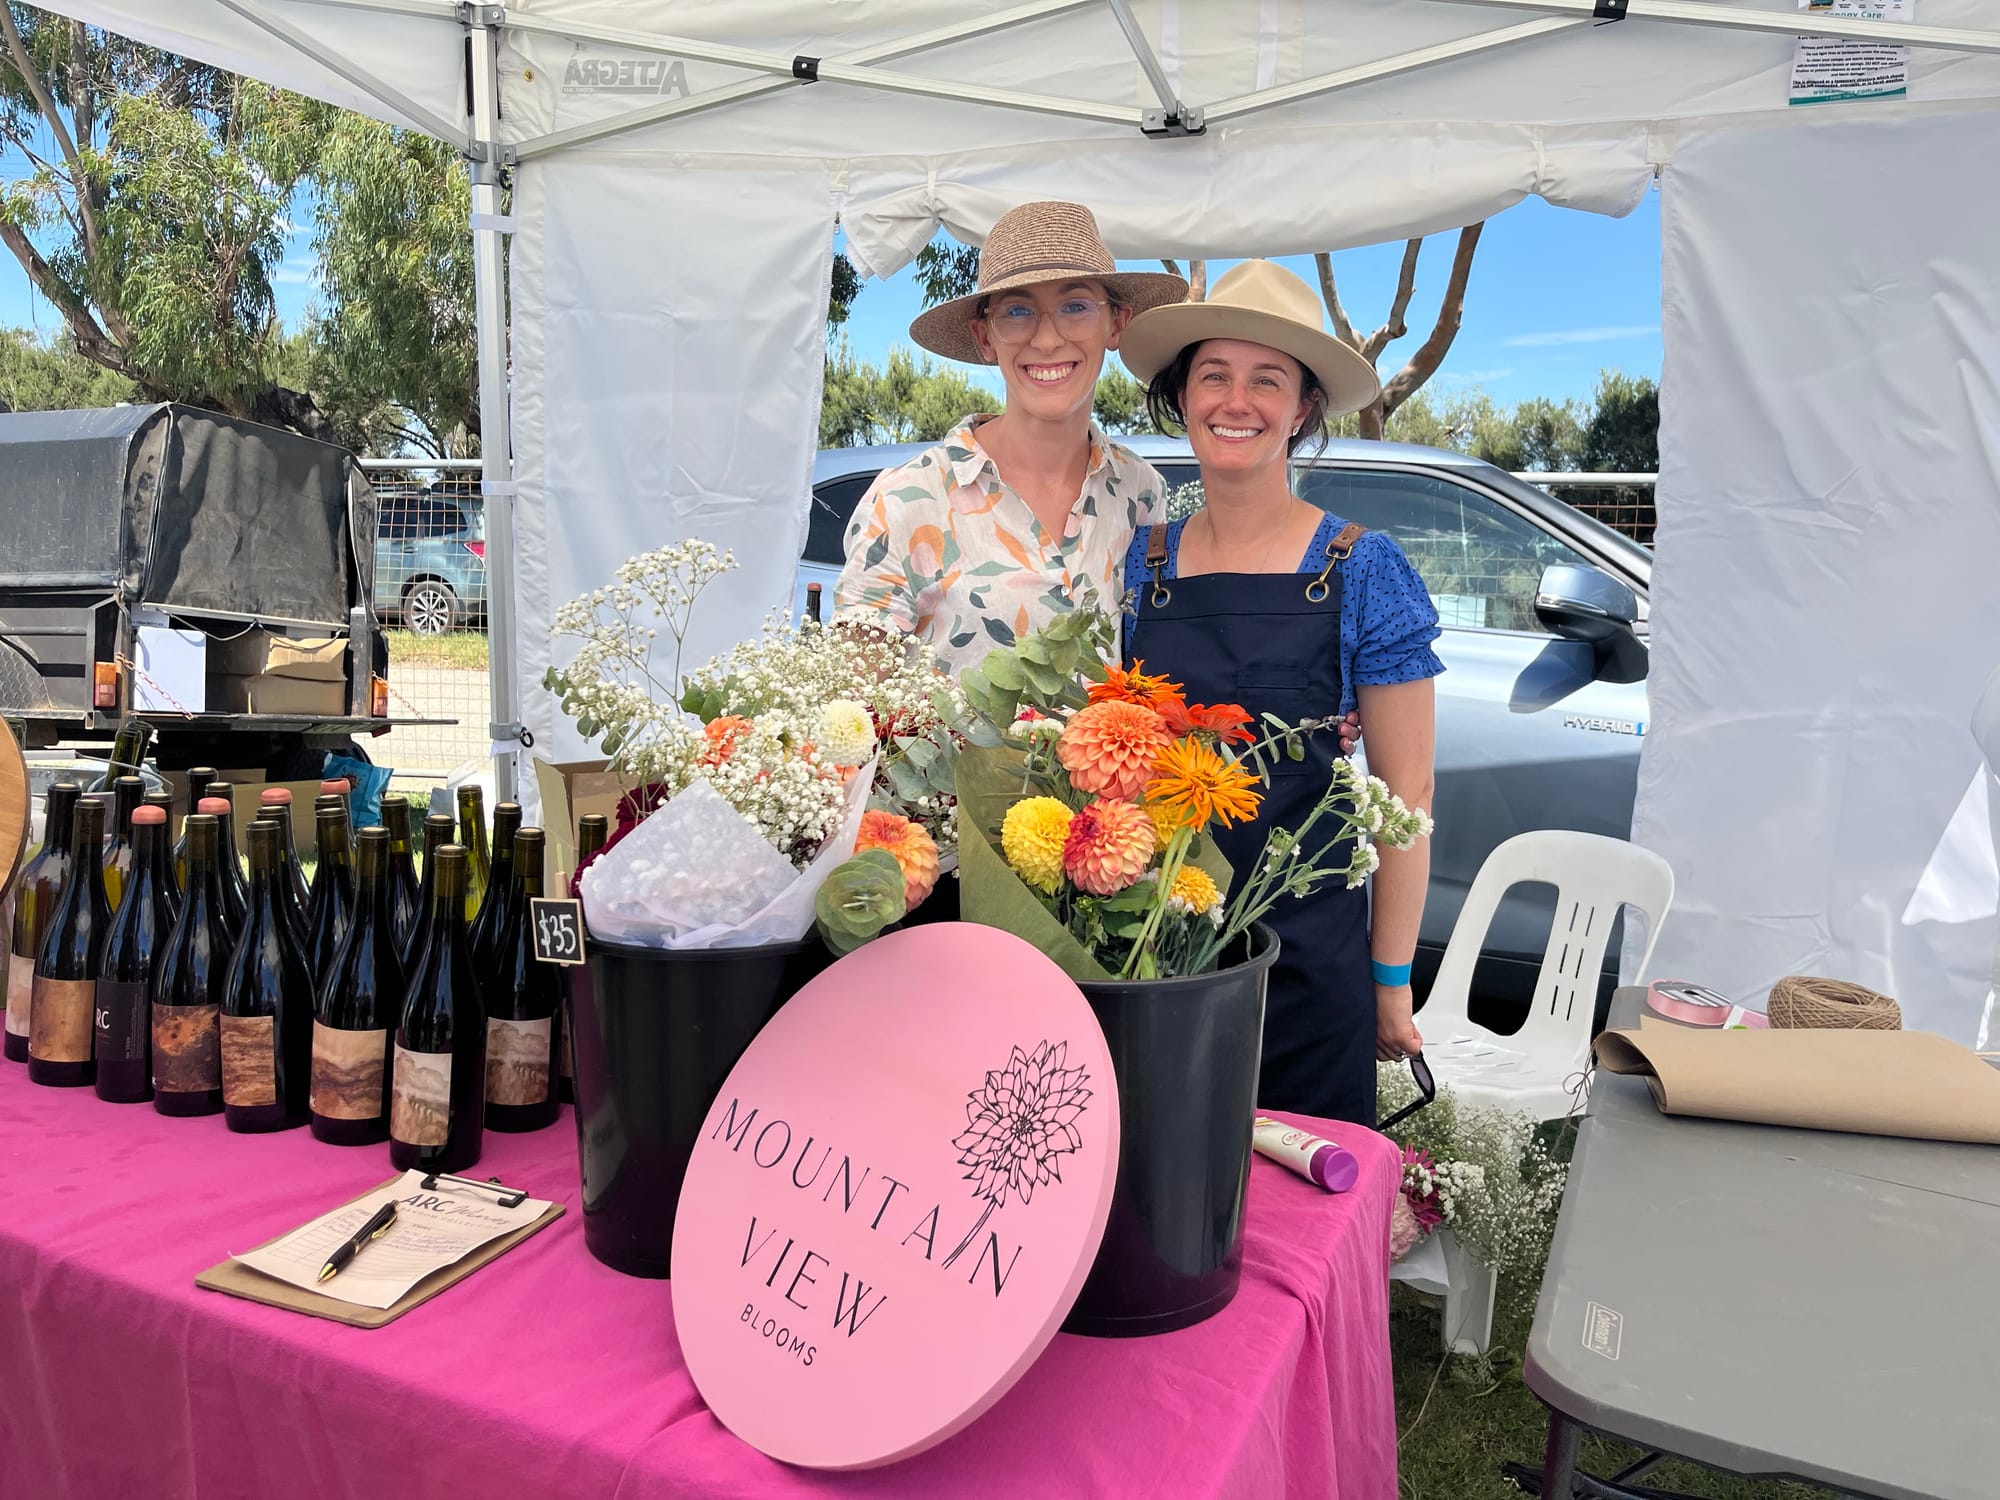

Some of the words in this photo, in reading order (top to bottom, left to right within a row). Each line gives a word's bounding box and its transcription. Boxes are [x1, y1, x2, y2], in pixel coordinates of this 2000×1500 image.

[1563, 715, 1634, 735] HYBRID
[539, 908, 576, 957] $35
[400, 1193, 455, 1212] ARC
[741, 1216, 887, 1338] VIEW
[740, 1303, 817, 1367] BLOOMS
